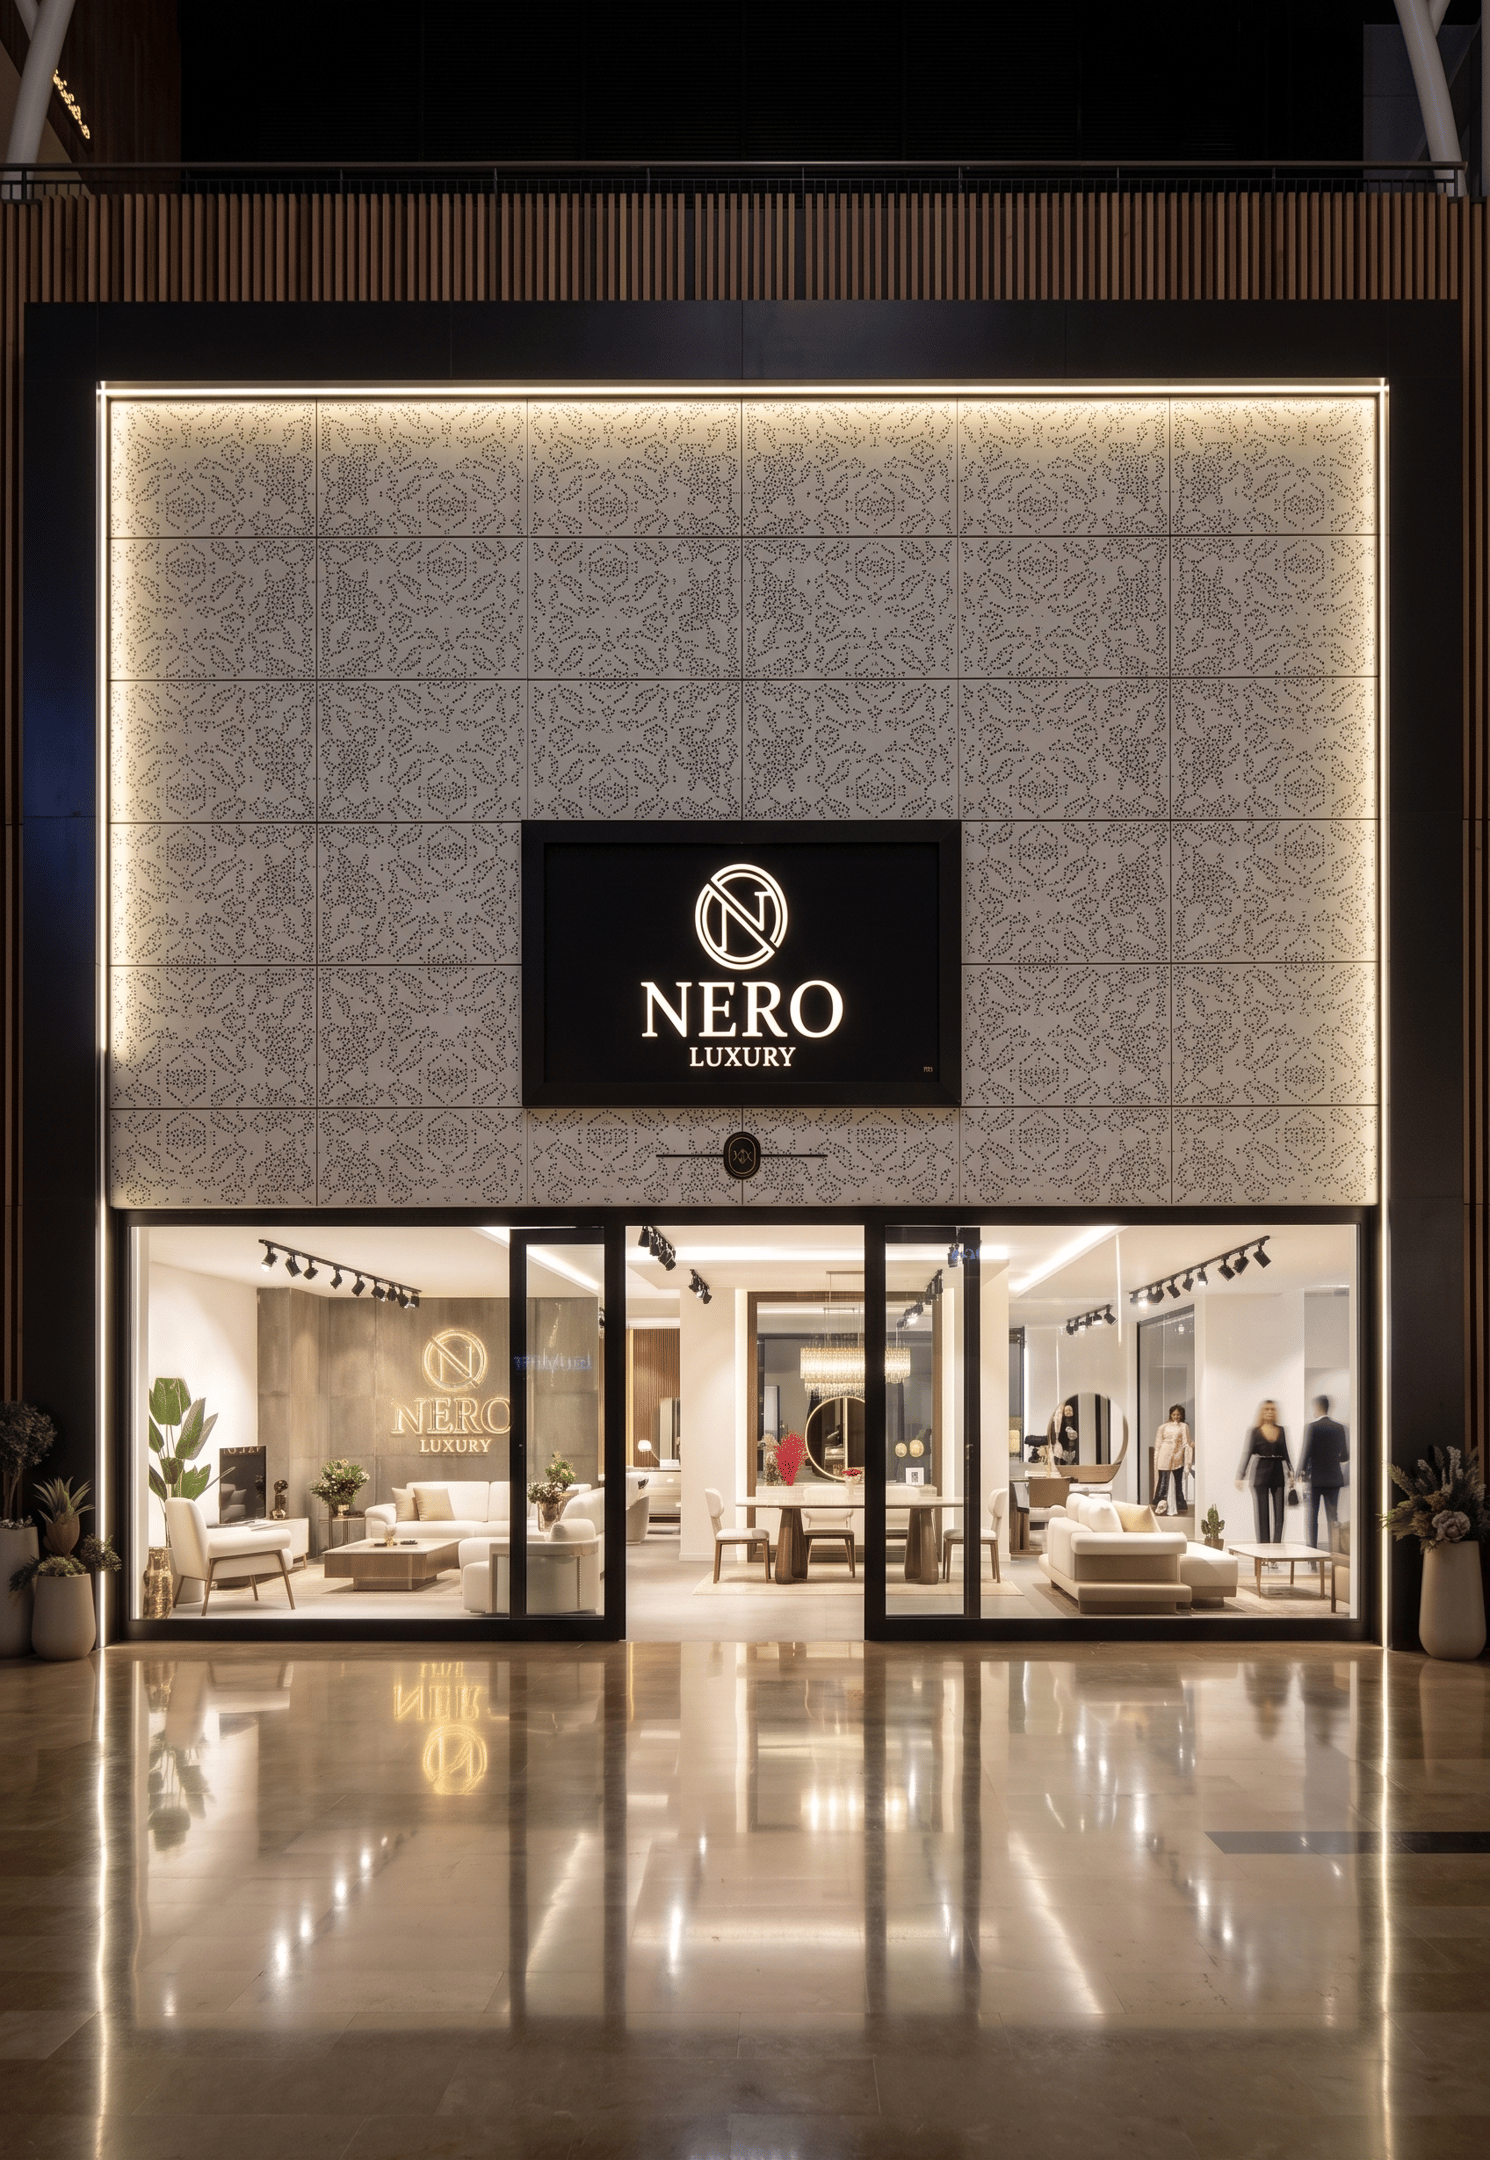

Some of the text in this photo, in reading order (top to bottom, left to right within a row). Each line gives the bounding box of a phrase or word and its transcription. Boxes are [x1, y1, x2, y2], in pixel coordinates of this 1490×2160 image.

[640, 979, 844, 1039] NERO
[689, 1046, 797, 1067] LUXURY
[391, 1397, 511, 1435] NERO
[419, 1439, 492, 1453] LUXURY
